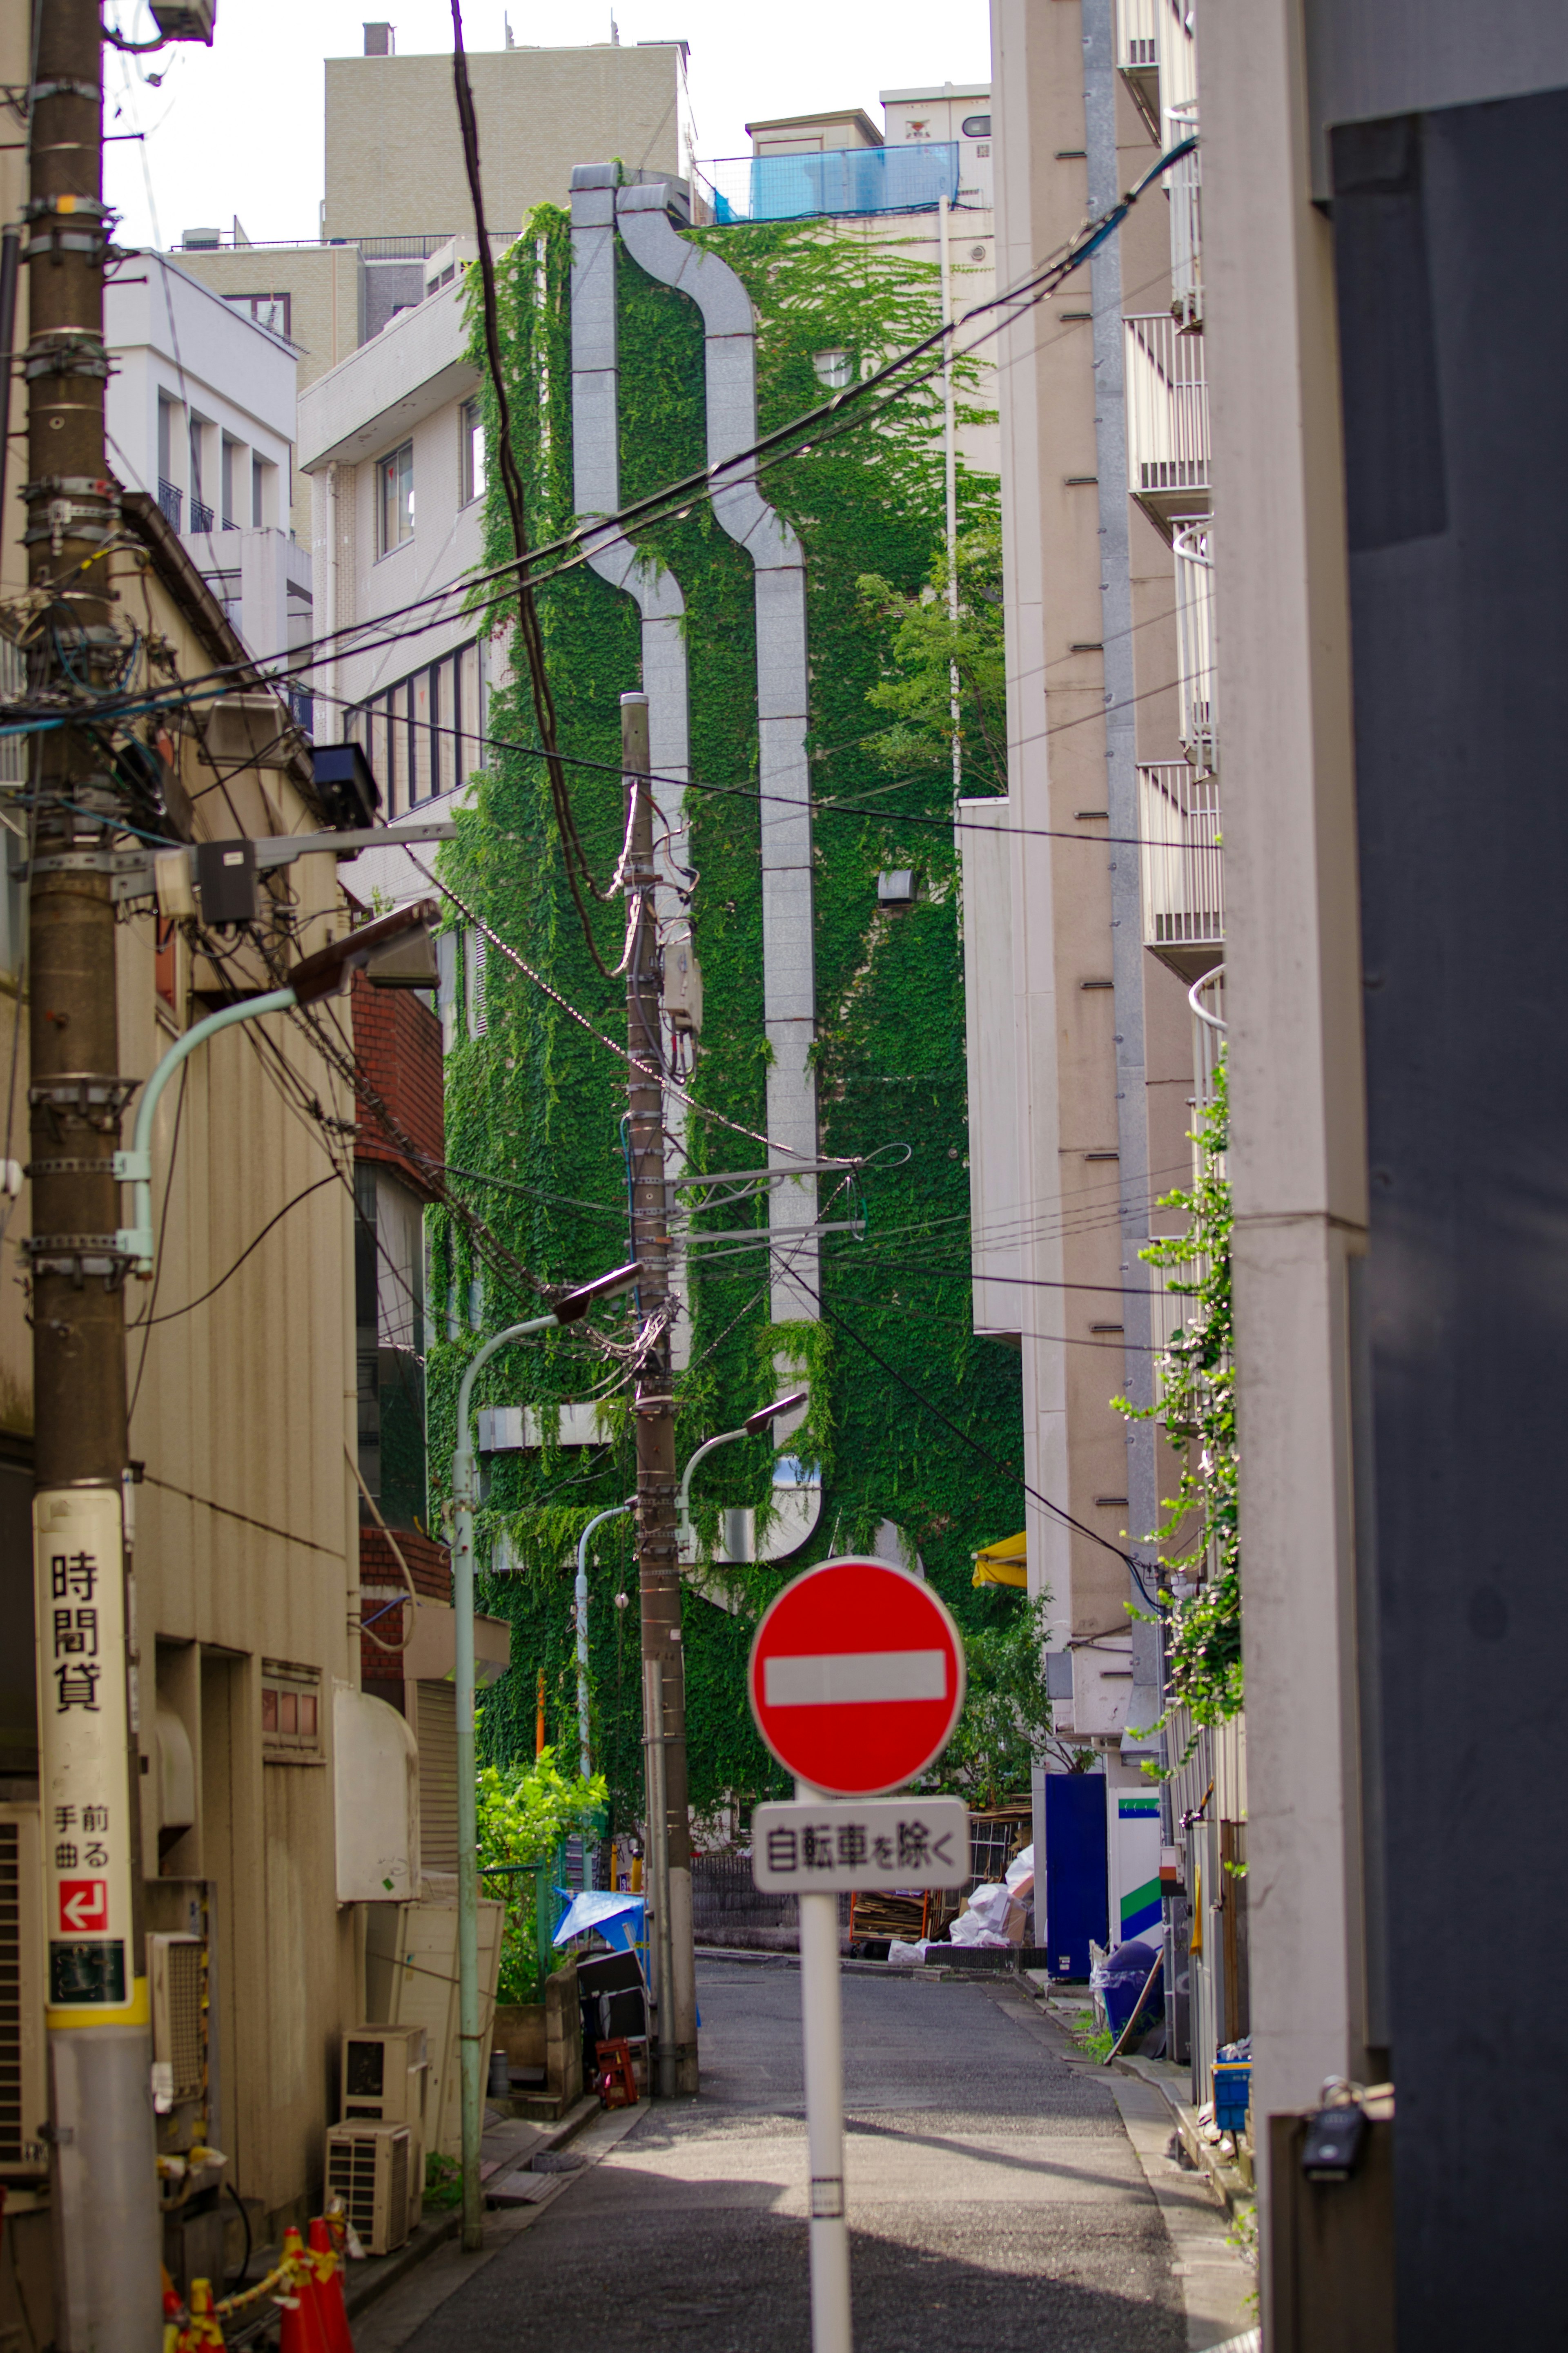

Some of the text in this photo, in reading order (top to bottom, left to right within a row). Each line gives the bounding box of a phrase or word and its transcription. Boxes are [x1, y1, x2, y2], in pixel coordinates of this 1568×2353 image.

[51, 1551, 101, 1713] 時間貸
[55, 1804, 109, 1832] 手前
[56, 1841, 108, 1868] 曲る
[768, 1820, 954, 1873] 自転車を除く
